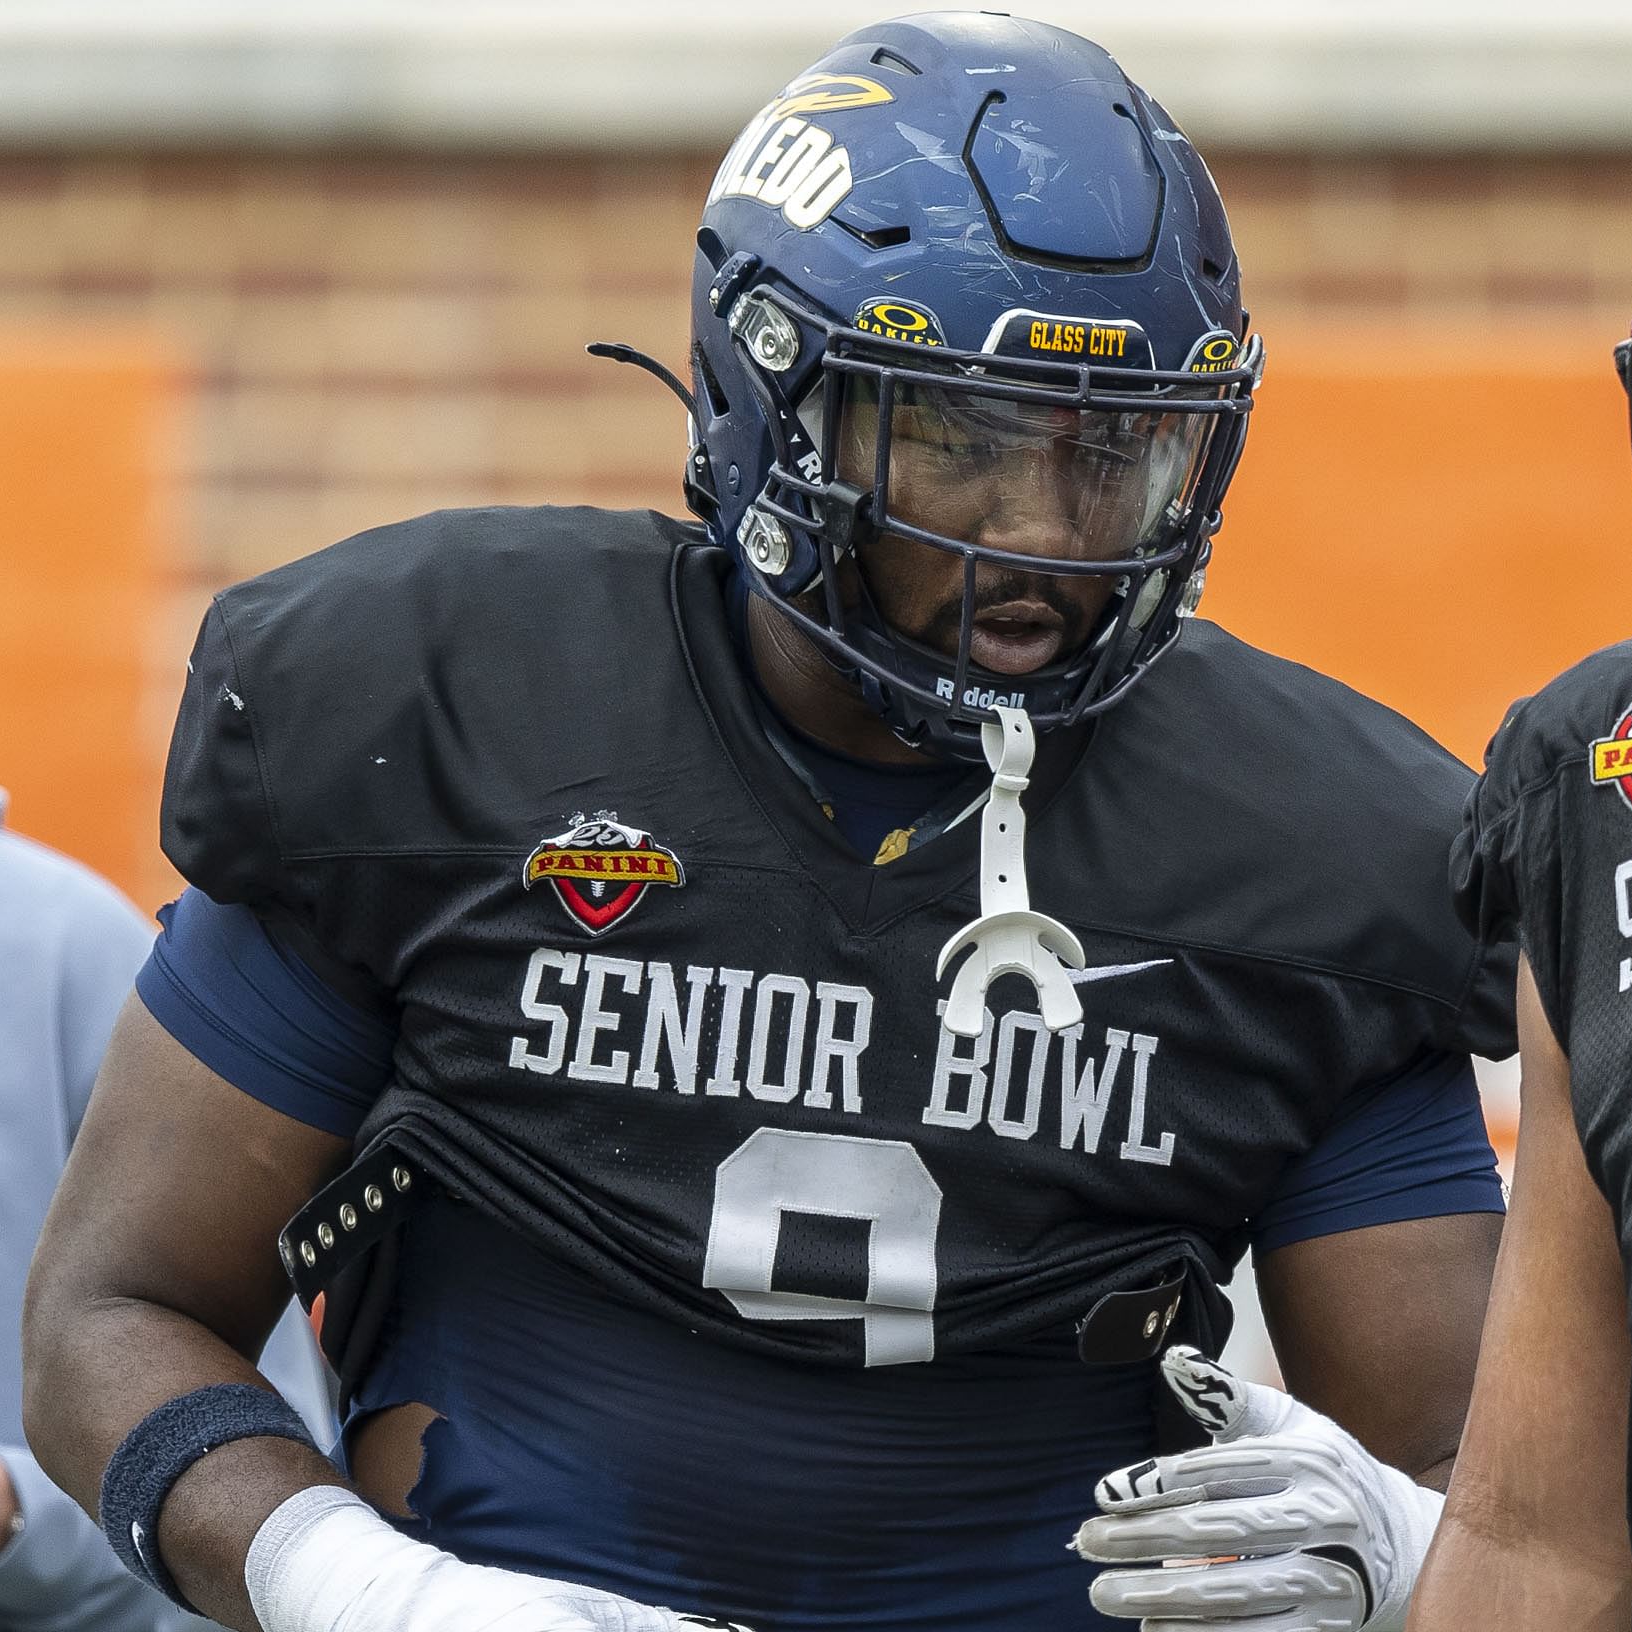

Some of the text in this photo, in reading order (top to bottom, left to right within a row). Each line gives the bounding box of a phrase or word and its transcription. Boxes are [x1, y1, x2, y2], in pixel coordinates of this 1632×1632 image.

[1029, 321, 1127, 357] GLASS CITY
[935, 676, 1026, 709] Rddell
[535, 854, 669, 875] PANINI
[509, 947, 1176, 1166] SENIOR BOWL
[702, 1126, 944, 1369] 9
